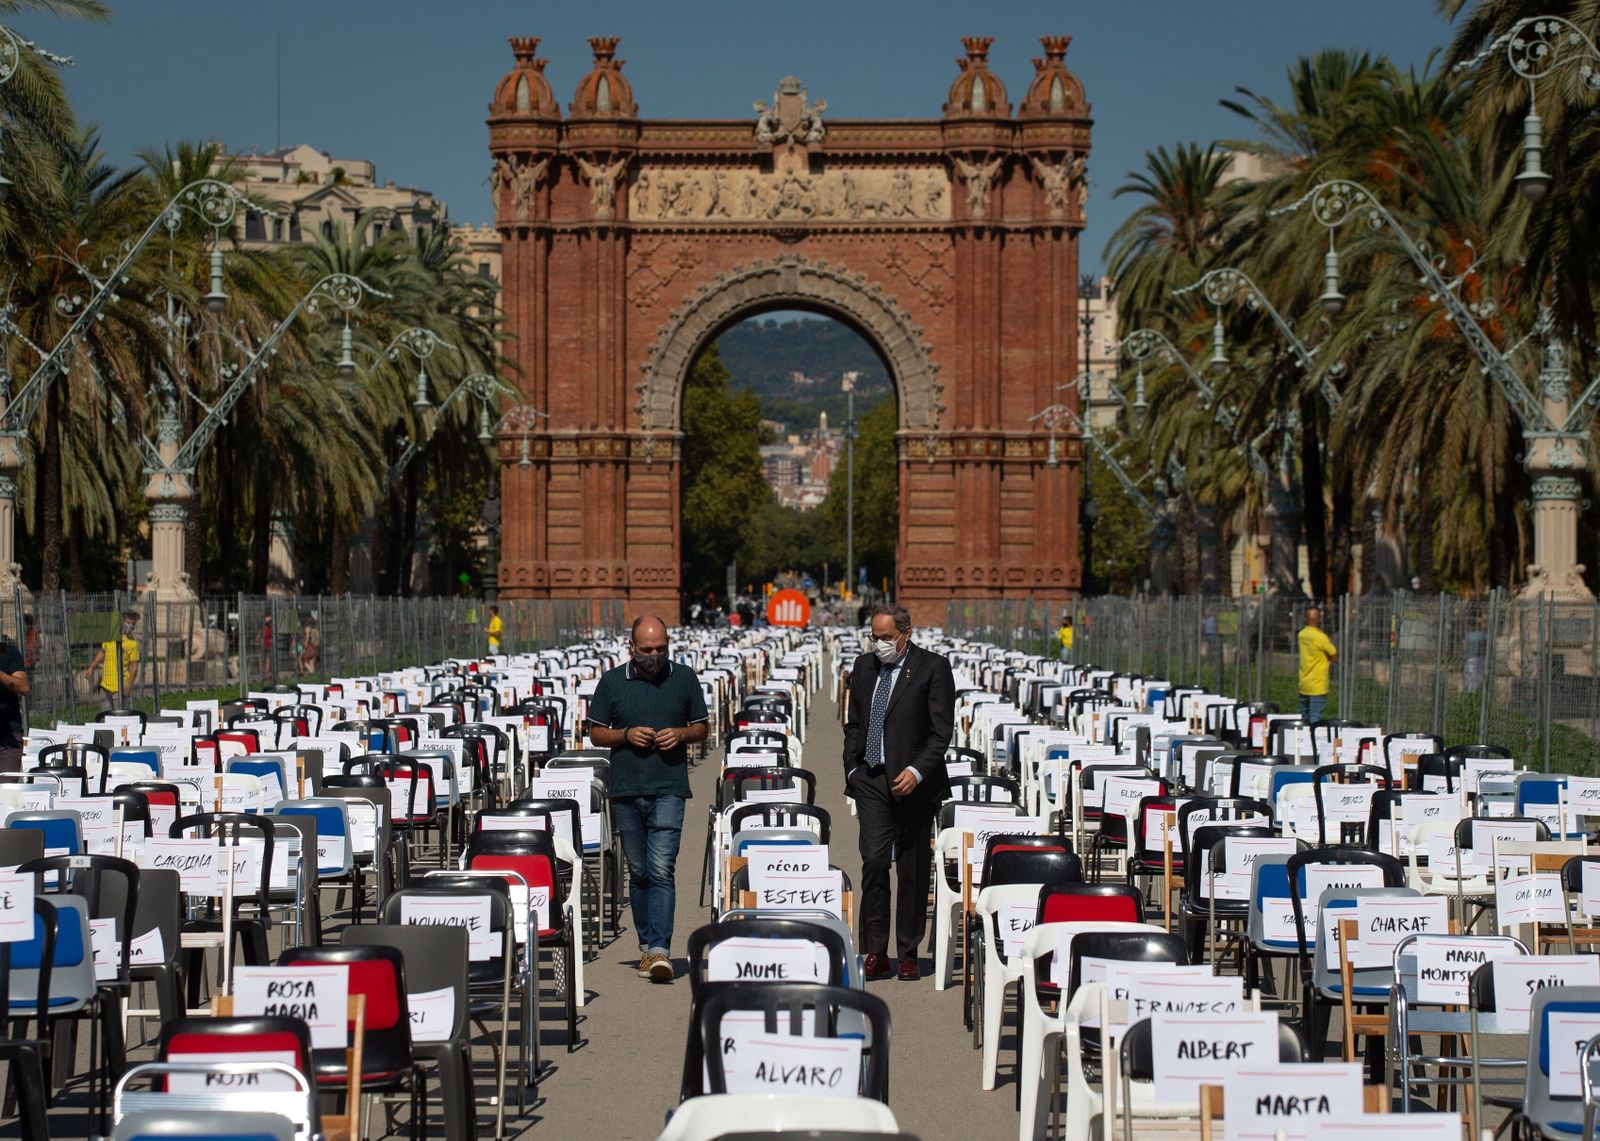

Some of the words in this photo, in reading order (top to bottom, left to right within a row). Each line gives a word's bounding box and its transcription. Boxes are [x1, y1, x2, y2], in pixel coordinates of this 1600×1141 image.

[547, 789, 578, 798] ERNEST
[1120, 789, 1143, 798] ELISA
[153, 854, 212, 872] CAROLINA
[763, 888, 836, 904] ESTEVE
[1370, 916, 1432, 933] CHARAF
[1445, 950, 1487, 964] MARIA
[735, 961, 790, 980] JAUME
[267, 980, 316, 999] ROSA
[1525, 975, 1566, 995] SAÜL
[264, 1002, 318, 1020] MARIA
[1176, 1040, 1254, 1060] ALBERT
[755, 1061, 844, 1088] ALVARO
[1256, 1094, 1331, 1116] MARTA
